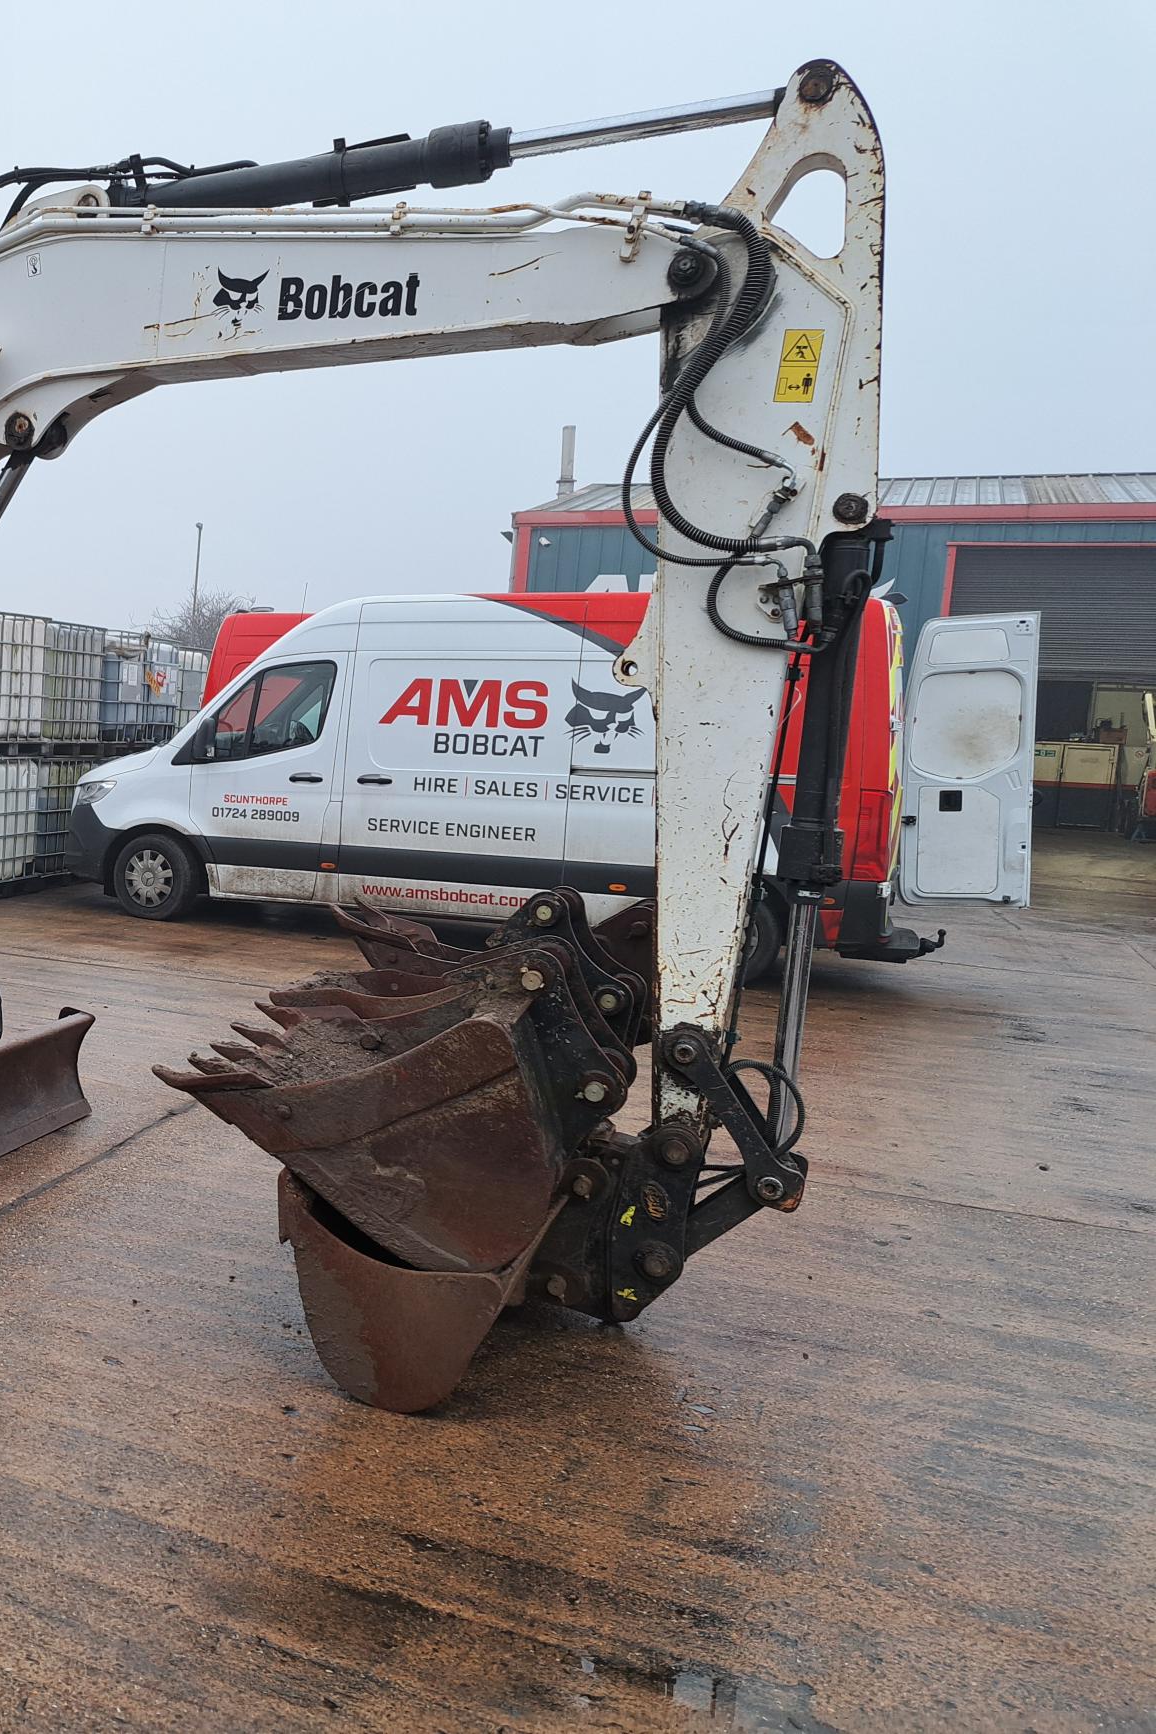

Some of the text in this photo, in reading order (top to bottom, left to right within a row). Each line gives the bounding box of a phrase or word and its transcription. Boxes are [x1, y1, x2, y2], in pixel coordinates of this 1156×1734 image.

[277, 272, 421, 321] Bobcat
[379, 678, 549, 728] AMS
[433, 732, 545, 758] BOBCAT
[224, 794, 288, 806] SCUNTHORPE
[413, 776, 645, 804] HIRE SALES SERVICE
[212, 806, 300, 822] 01724 289009
[367, 817, 536, 842] SERVICE ENGINEER
